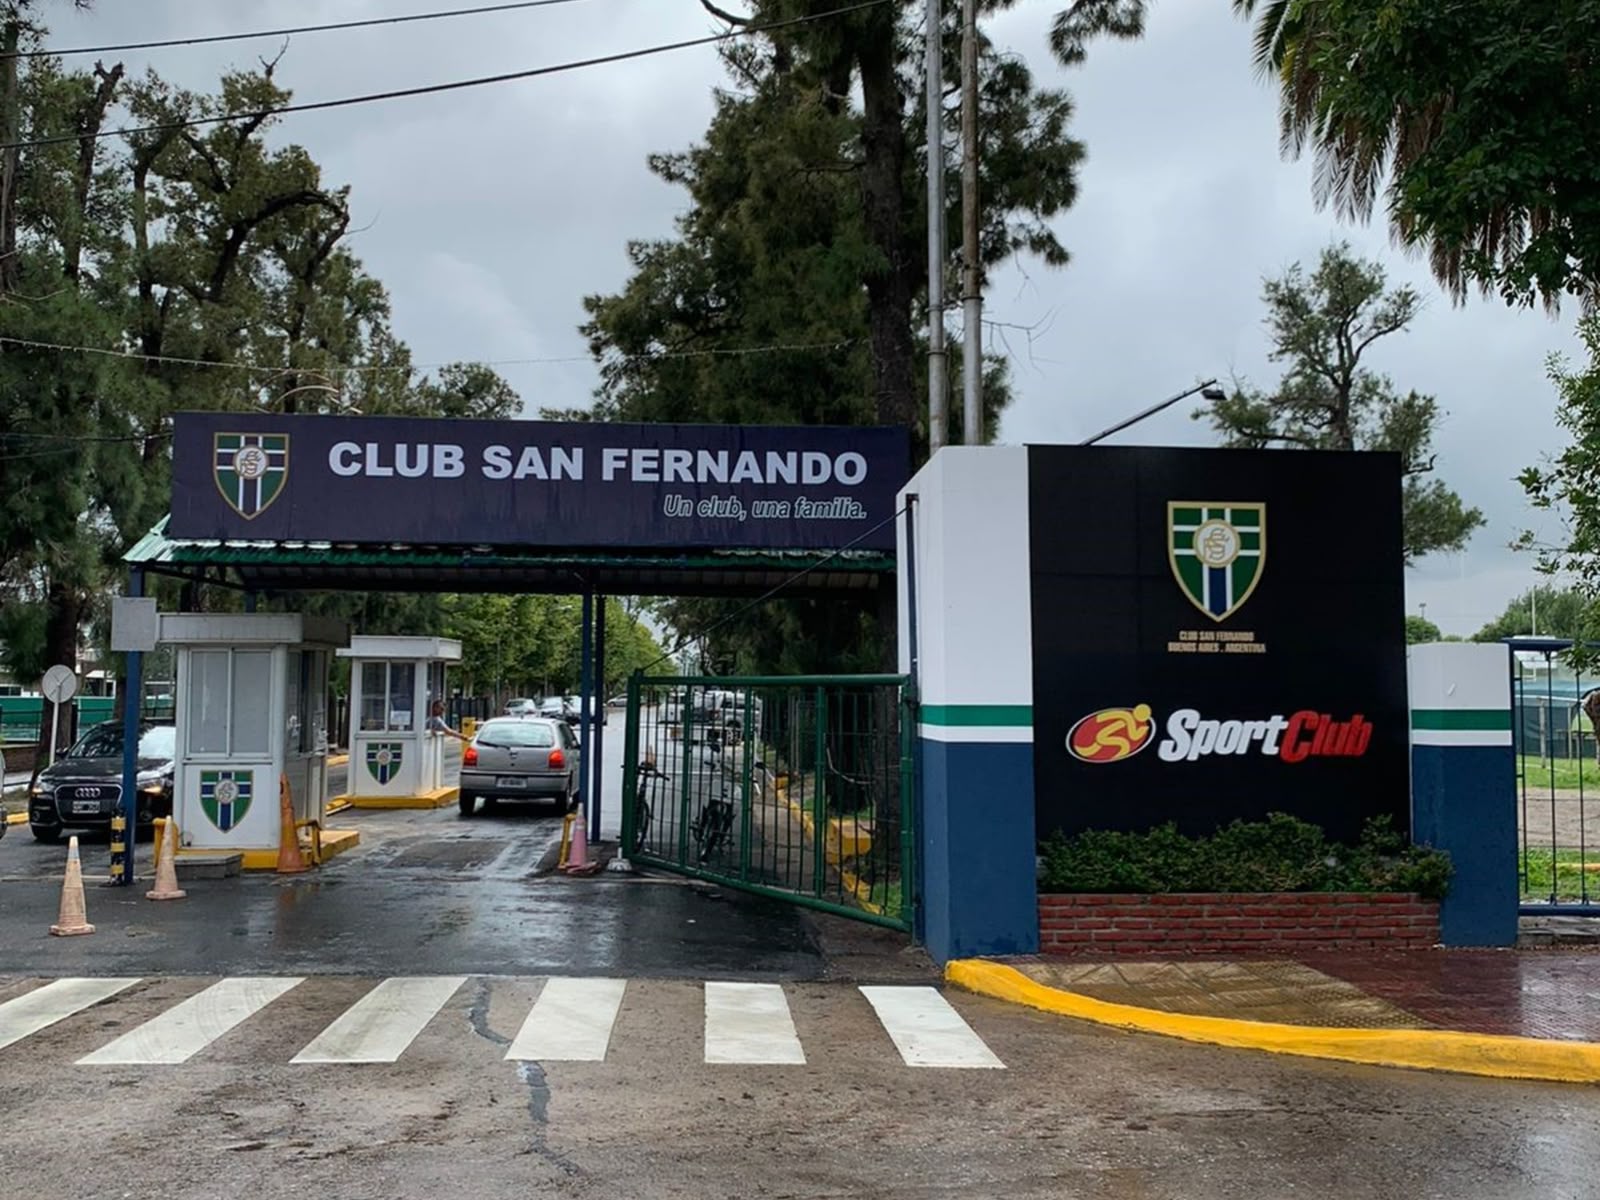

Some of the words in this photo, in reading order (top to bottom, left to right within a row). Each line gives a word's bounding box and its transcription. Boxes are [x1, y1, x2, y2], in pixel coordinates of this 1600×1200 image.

[329, 442, 465, 477] CLUB
[481, 445, 583, 480] SAN
[602, 448, 868, 485] FERNANDO
[664, 495, 693, 516] Un
[697, 496, 747, 521] club,
[752, 500, 790, 518] una
[794, 496, 867, 519] familia.
[1158, 709, 1373, 762] SportClub
